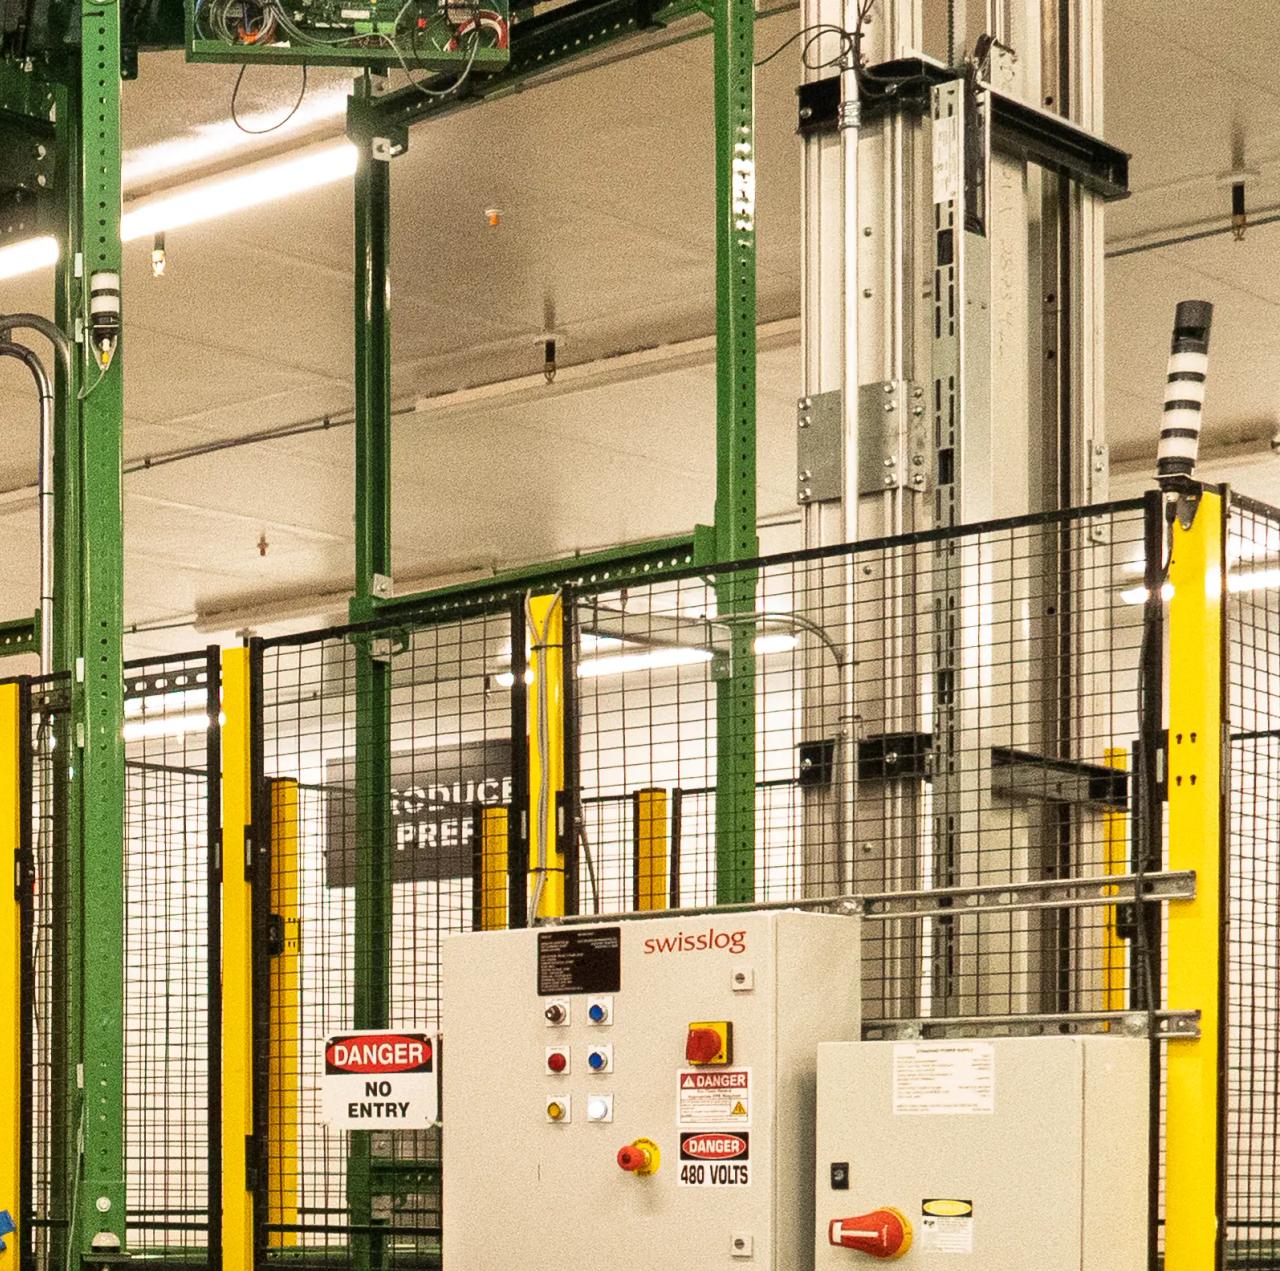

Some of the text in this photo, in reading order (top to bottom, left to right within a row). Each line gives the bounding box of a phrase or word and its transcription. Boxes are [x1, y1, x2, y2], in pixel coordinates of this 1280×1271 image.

[644, 928, 747, 955] swisslog
[334, 1043, 424, 1066] DANGER
[365, 1081, 392, 1097] NO
[697, 1074, 746, 1088] DANGER
[348, 1102, 410, 1118] ENTRY
[689, 1139, 740, 1153] DANGER
[681, 1165, 748, 1184] 480 VOLTS
